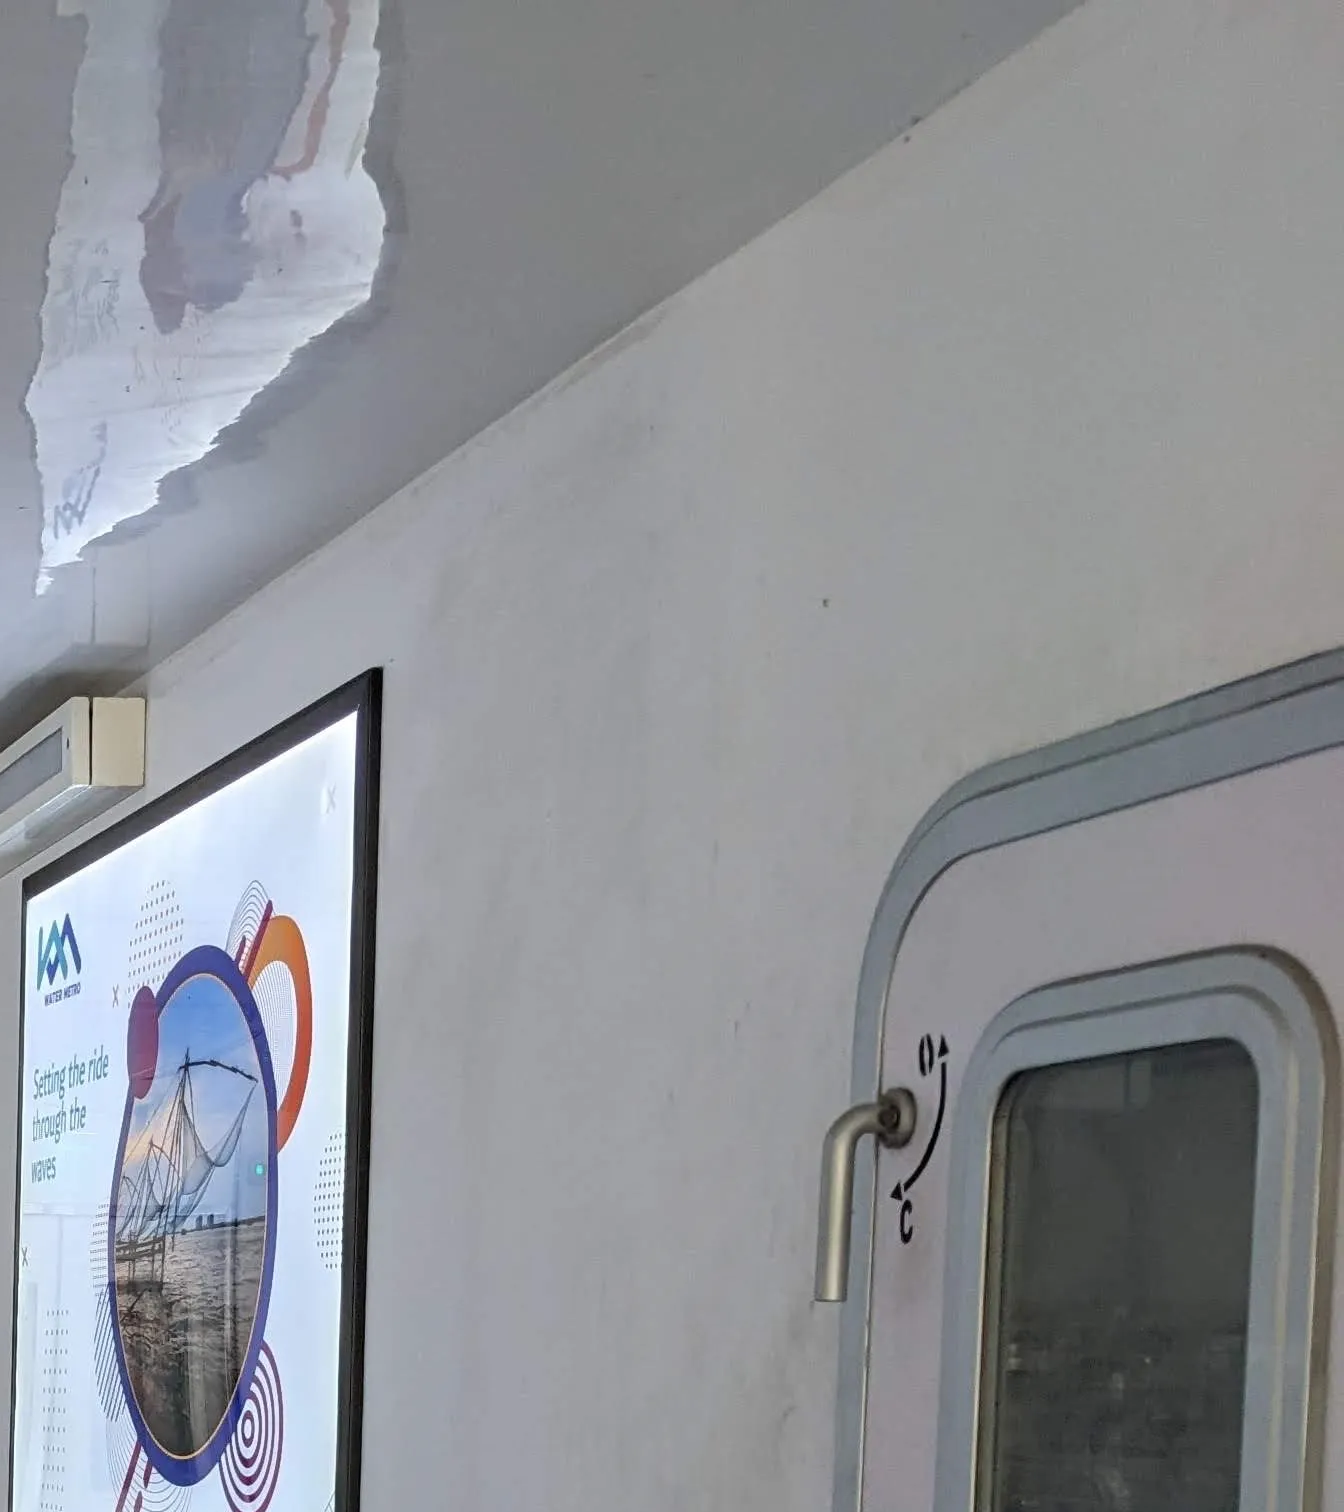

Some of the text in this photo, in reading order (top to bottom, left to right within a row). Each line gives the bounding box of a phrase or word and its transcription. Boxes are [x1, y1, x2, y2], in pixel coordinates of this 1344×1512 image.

[33, 1044, 110, 1100] Setting the ride
[32, 1096, 87, 1144] through the
[31, 1156, 57, 1184] waves
[899, 1199, 913, 1244] C
